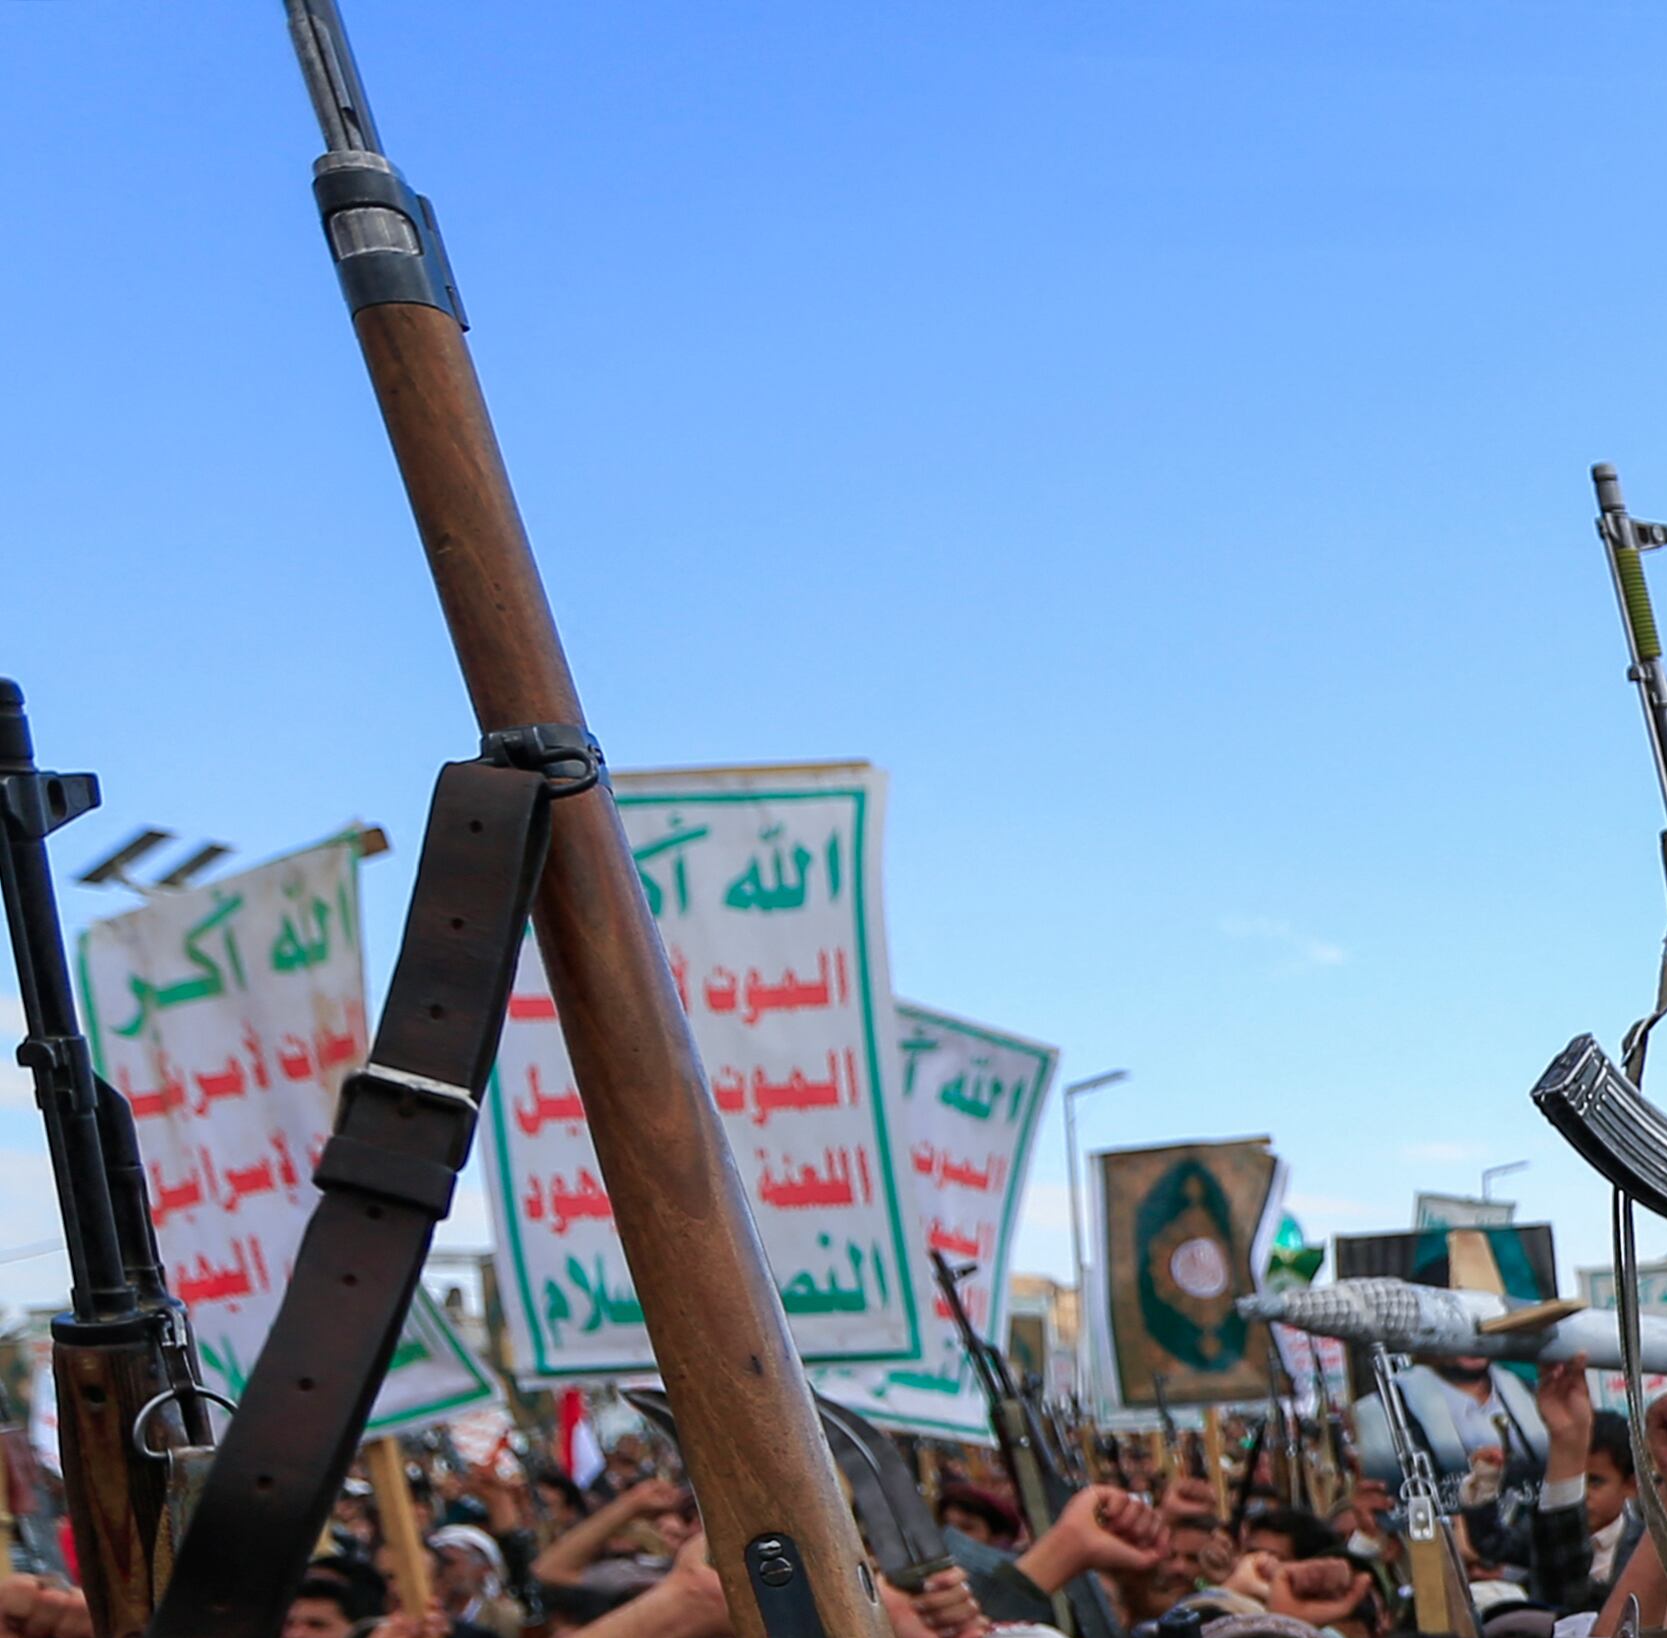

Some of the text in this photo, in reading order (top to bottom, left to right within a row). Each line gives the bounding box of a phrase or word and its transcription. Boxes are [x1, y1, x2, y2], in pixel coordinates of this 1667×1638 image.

[723, 820, 843, 911] الله
[703, 945, 849, 1025] الموت
[711, 1047, 859, 1127] الموت
[755, 1145, 874, 1208] اللعنة
